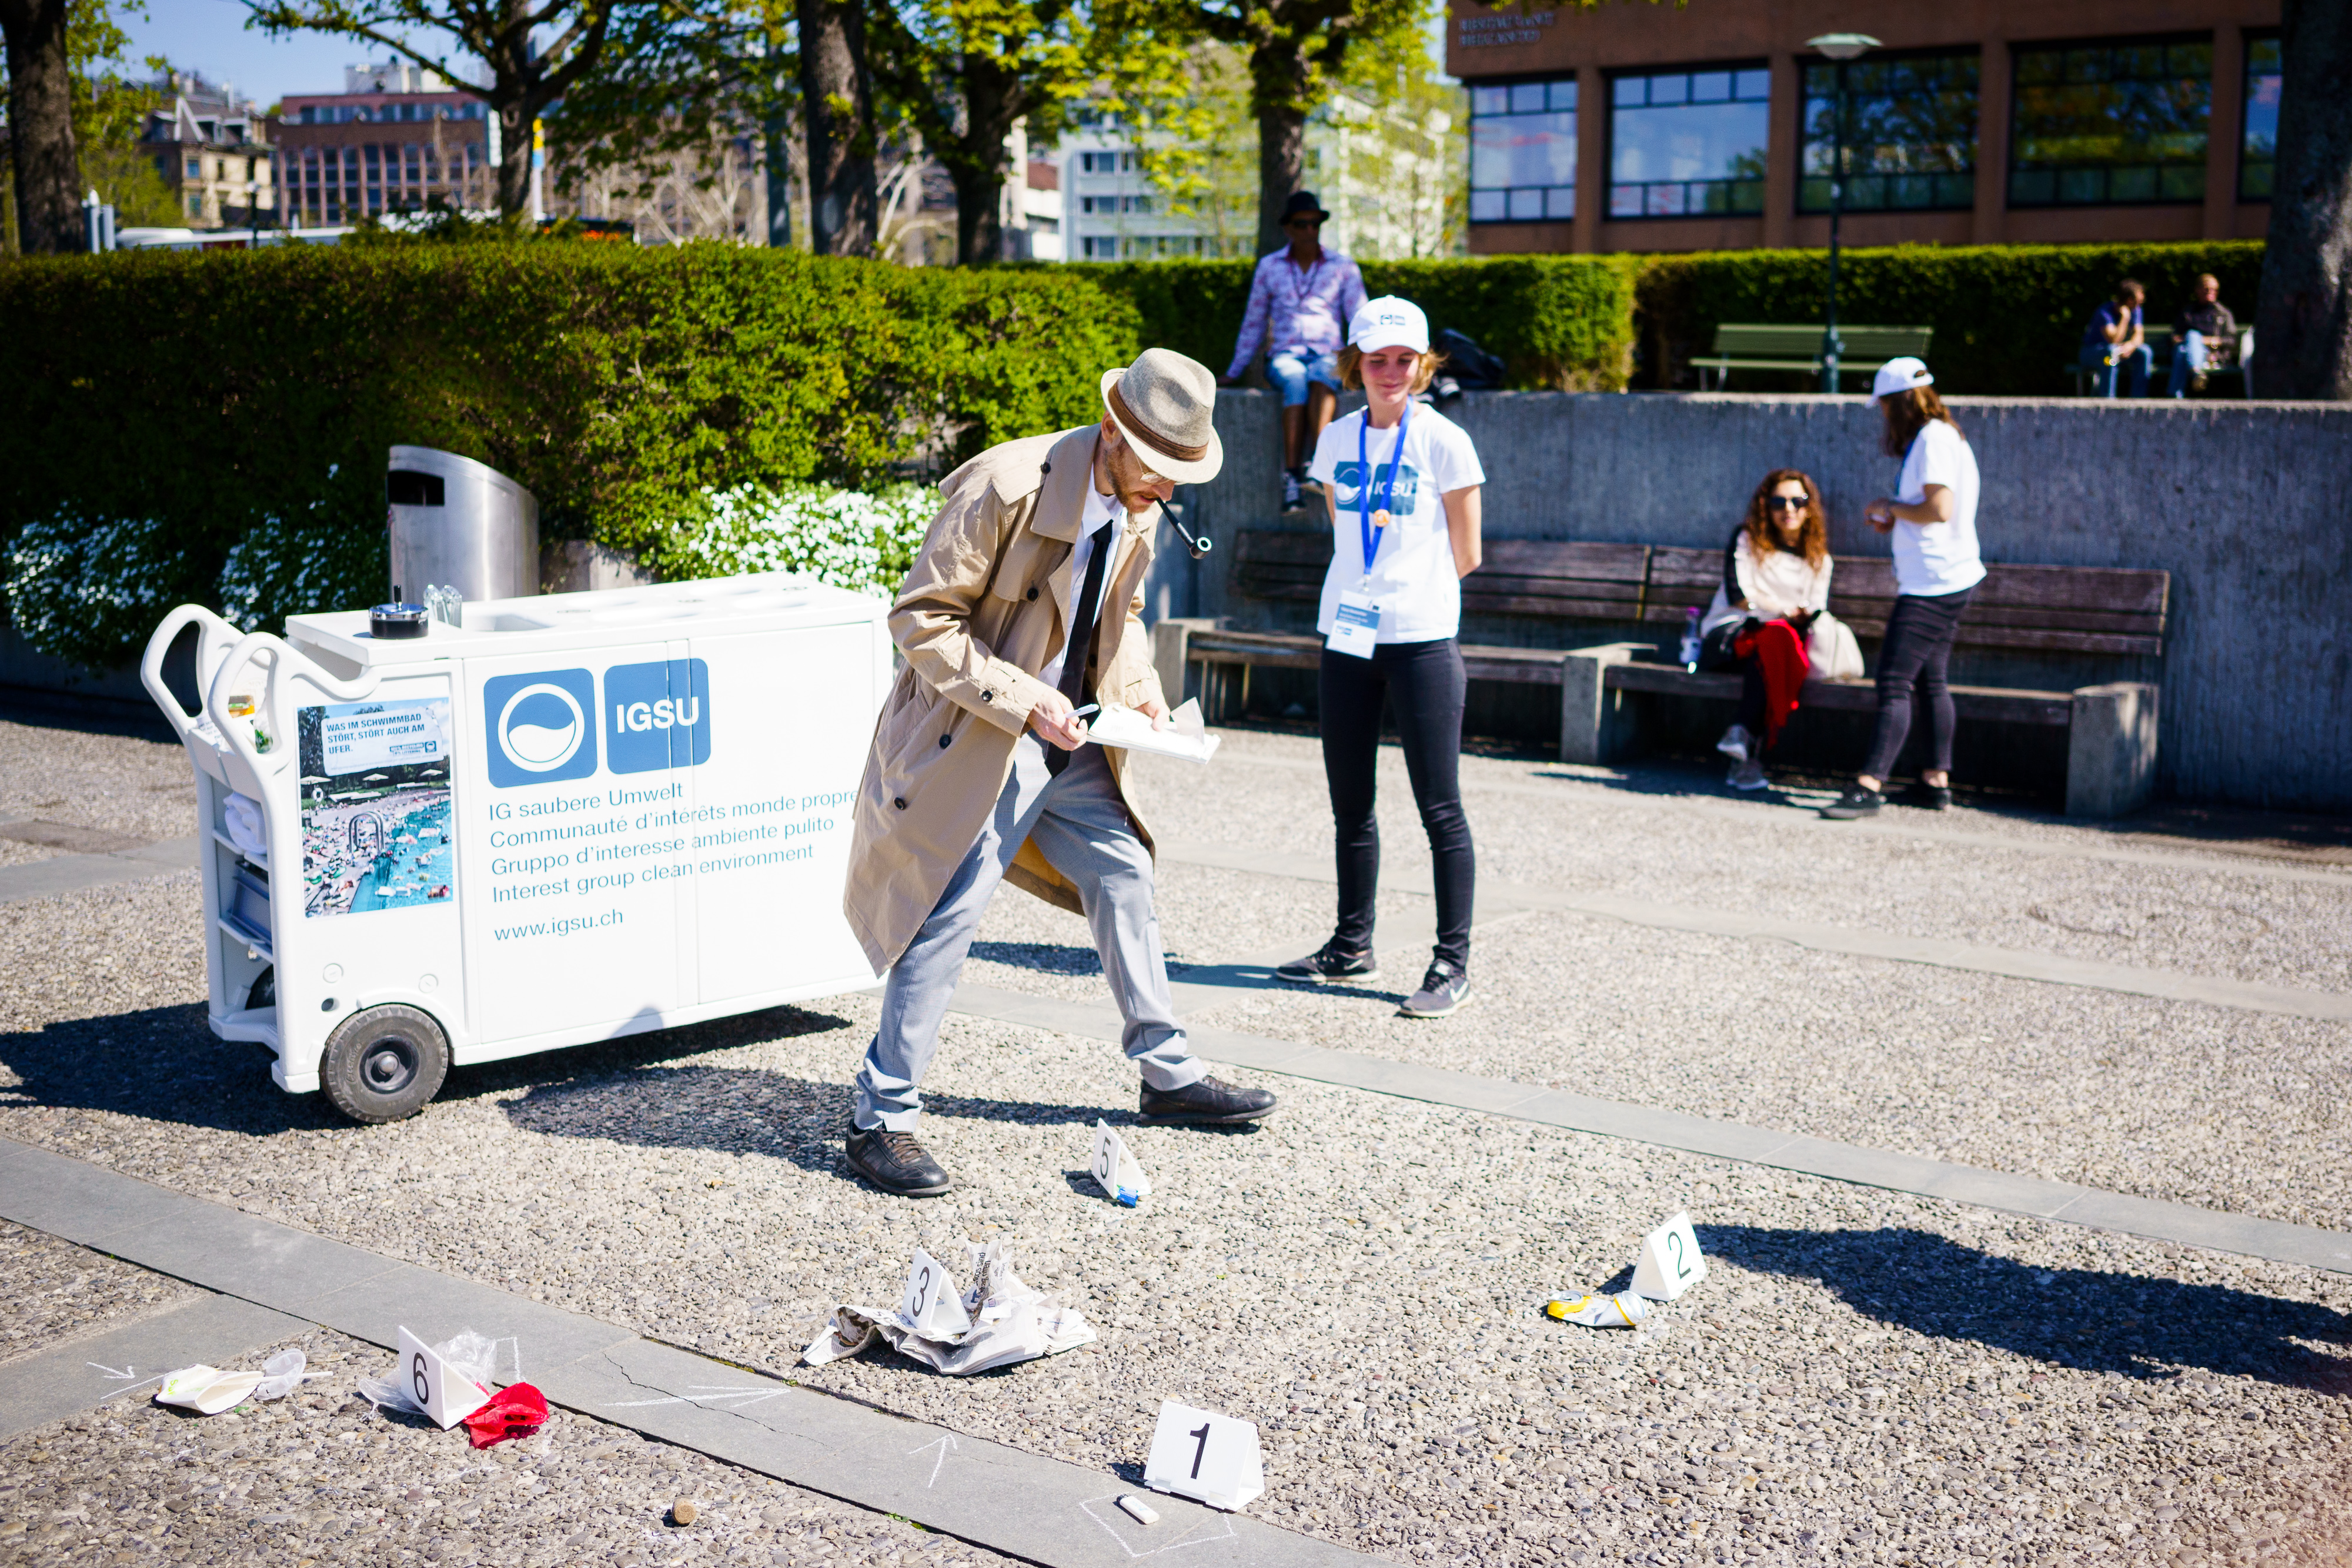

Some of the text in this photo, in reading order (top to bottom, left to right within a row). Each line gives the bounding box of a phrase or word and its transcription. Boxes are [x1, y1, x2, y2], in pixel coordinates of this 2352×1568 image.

[326, 723, 345, 732] WAS
[361, 713, 422, 728] SCHWIMMBAD
[328, 724, 425, 743] STÖRT, STÖRT AUCH AM
[617, 696, 699, 733] IGSU
[329, 744, 353, 754] UFER.
[490, 783, 683, 821] IG saubere Umwelt
[490, 790, 858, 848] Communauté d'intérêts monde propre
[492, 817, 834, 875] Gruppo d'interesse ambiente pulito
[493, 844, 813, 902] Interest group clean environment
[495, 909, 623, 941] www.igsu.ch
[1100, 1136, 1111, 1179] 5
[977, 1252, 986, 1267] sind
[1668, 1231, 1691, 1279] 2
[912, 1266, 930, 1317] 3
[413, 1352, 429, 1405] 6
[1190, 1423, 1210, 1479] 1
